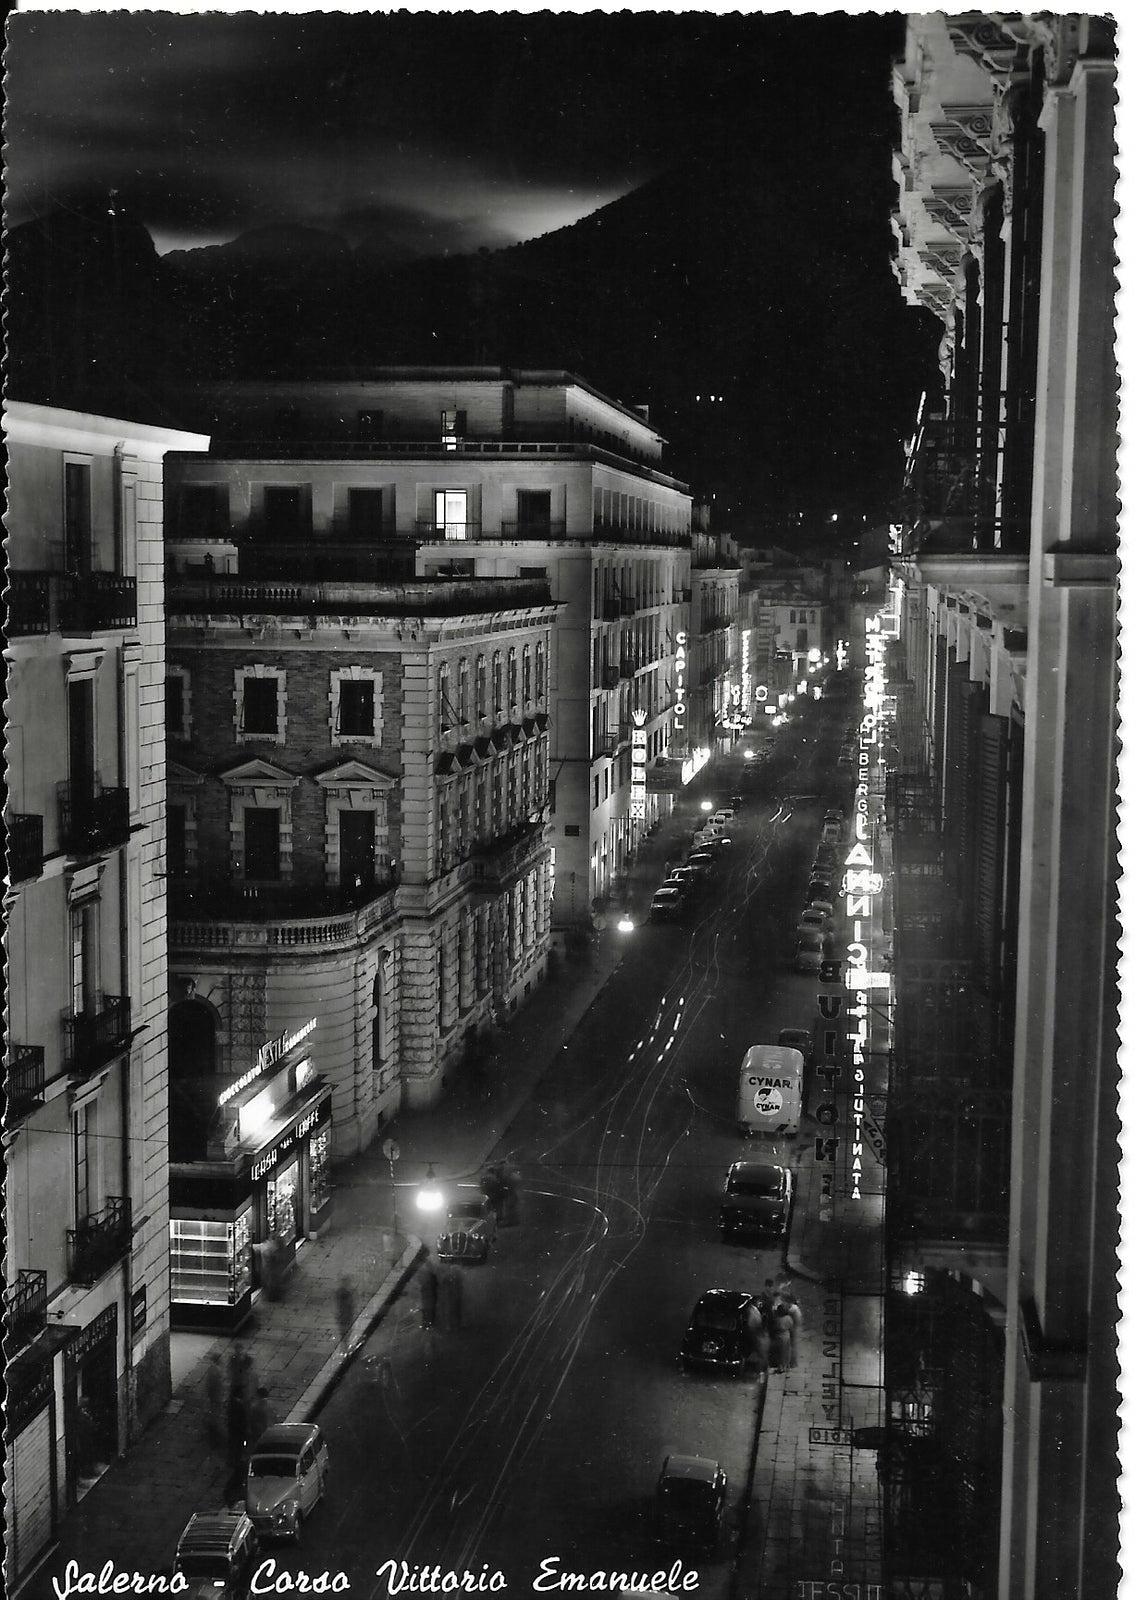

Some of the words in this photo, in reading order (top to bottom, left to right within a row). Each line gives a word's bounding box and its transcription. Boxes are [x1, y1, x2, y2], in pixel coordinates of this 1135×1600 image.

[674, 631, 686, 729] CAPITOL
[631, 729, 647, 819] ROLEX
[756, 1102, 781, 1112] CYNAR
